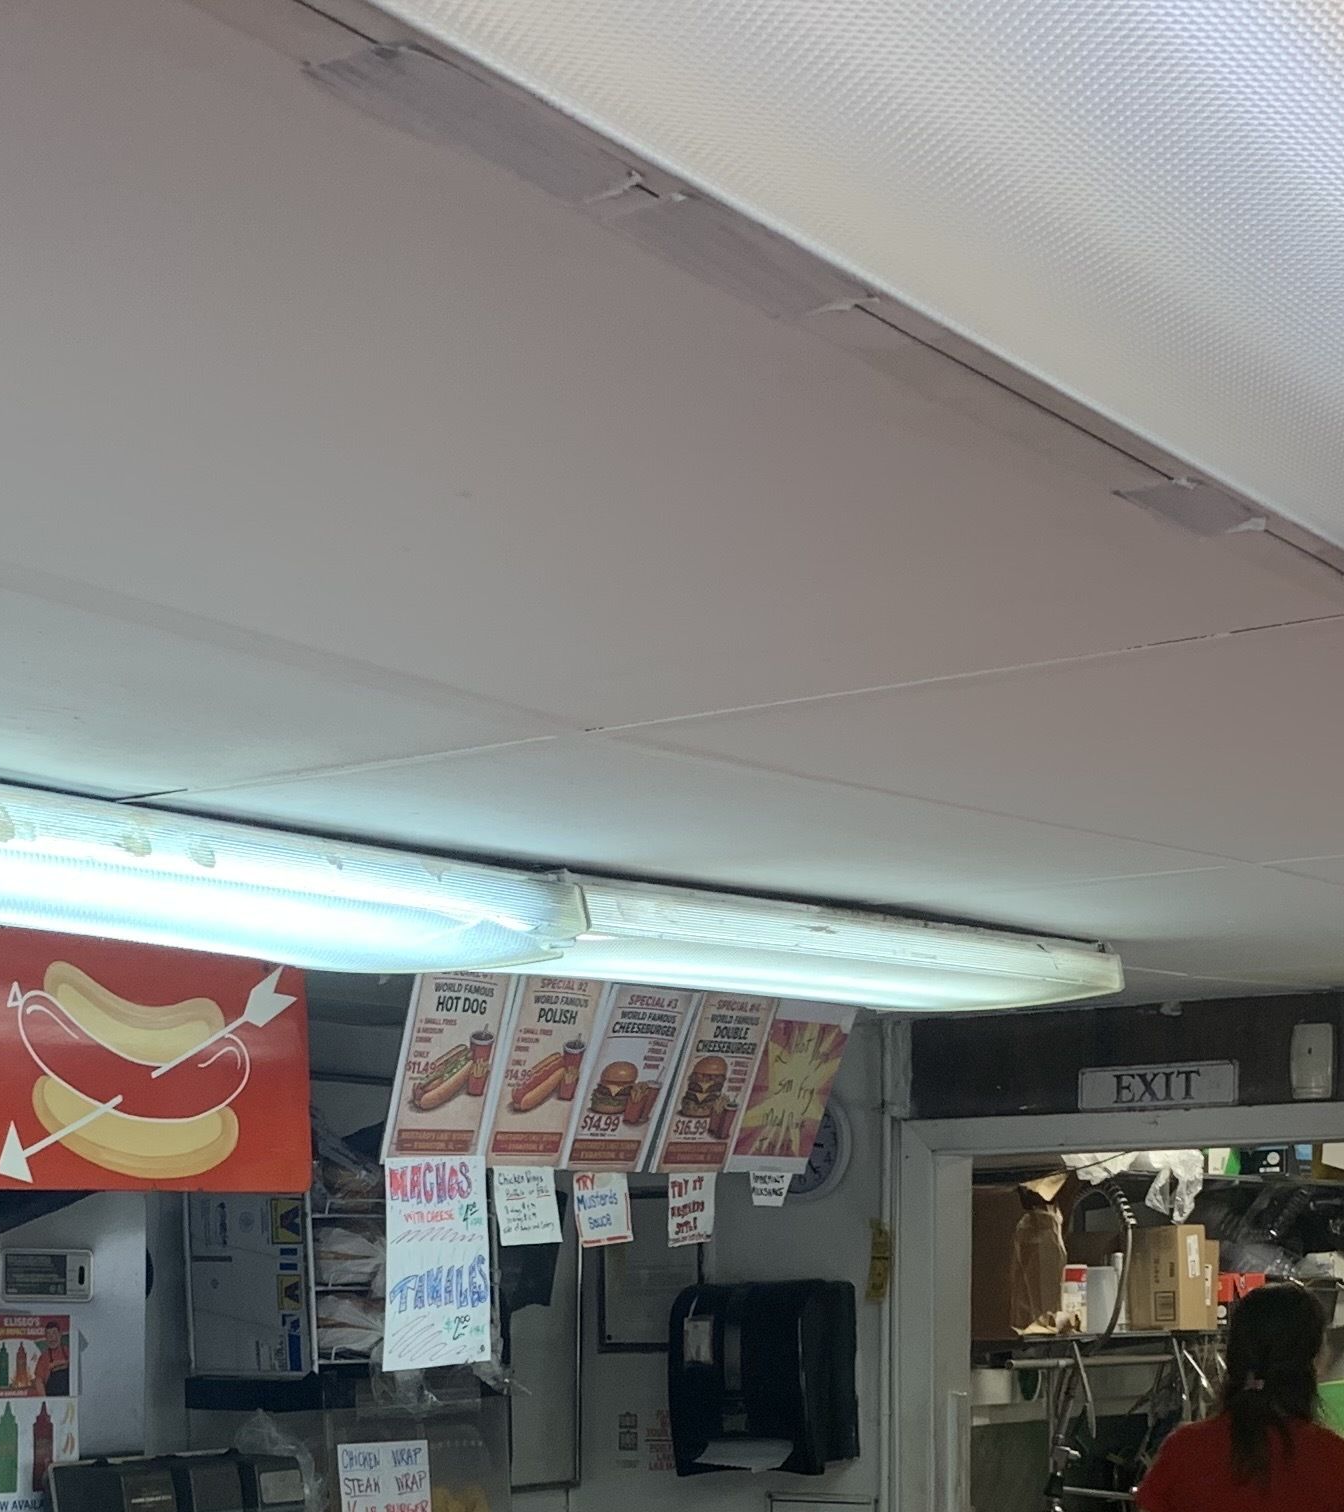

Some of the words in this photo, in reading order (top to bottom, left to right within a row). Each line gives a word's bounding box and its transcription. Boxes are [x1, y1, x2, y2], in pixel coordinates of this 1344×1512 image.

[434, 982, 463, 993] WORLD
[464, 985, 495, 997] FAMOUS
[436, 996, 461, 1012] HOT
[462, 997, 487, 1015] DOG
[628, 994, 665, 1008] SPECIAL
[537, 1008, 578, 1025] POLISH
[620, 1010, 647, 1021] WORLD
[648, 1012, 677, 1024] FAMOUS
[612, 1021, 677, 1037] CHEESEBURGER
[713, 1026, 751, 1040] DOUBLE
[695, 1040, 757, 1056] CHEESEBURGER
[1113, 1069, 1201, 1103] EXIT
[581, 1114, 621, 1132] $14.99
[673, 1119, 707, 1136] $16.99
[389, 1161, 473, 1205] NACHOS
[576, 1174, 595, 1192] TRY
[425, 1210, 456, 1224] CHEESE
[389, 1254, 490, 1315] TAMALES
[342, 1448, 381, 1469] CHICKEN
[392, 1447, 422, 1467] WRAP
[343, 1477, 381, 1496] STEAK
[395, 1470, 427, 1492] WRAP
